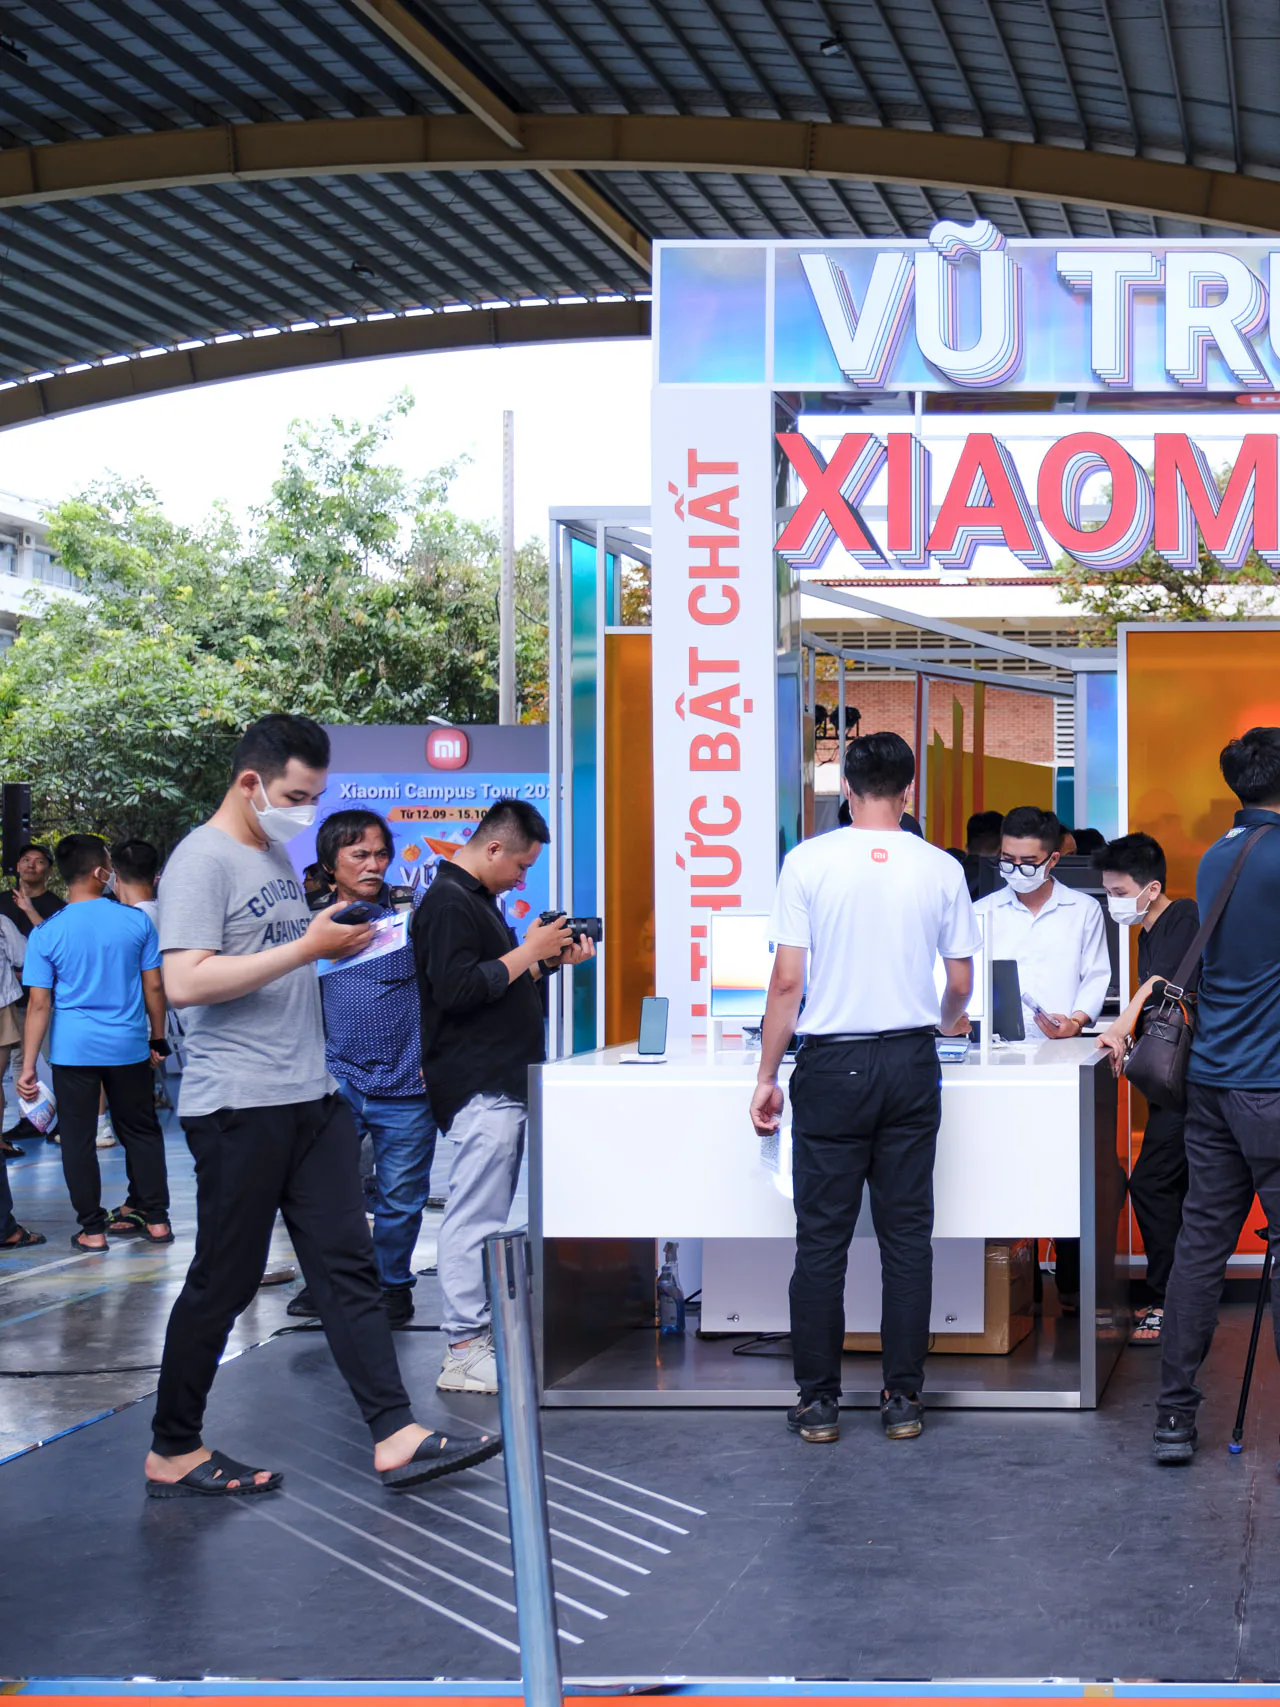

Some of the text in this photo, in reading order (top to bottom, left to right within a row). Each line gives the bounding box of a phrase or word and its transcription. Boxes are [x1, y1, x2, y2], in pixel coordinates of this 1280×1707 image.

[799, 220, 1023, 388] VŨ
[668, 449, 741, 625] CHẤT
[675, 647, 753, 771] BẬT
[340, 782, 400, 799] Xiaomi
[405, 783, 476, 802] Campus
[480, 783, 520, 799] Tour
[417, 809, 446, 820] 12.09
